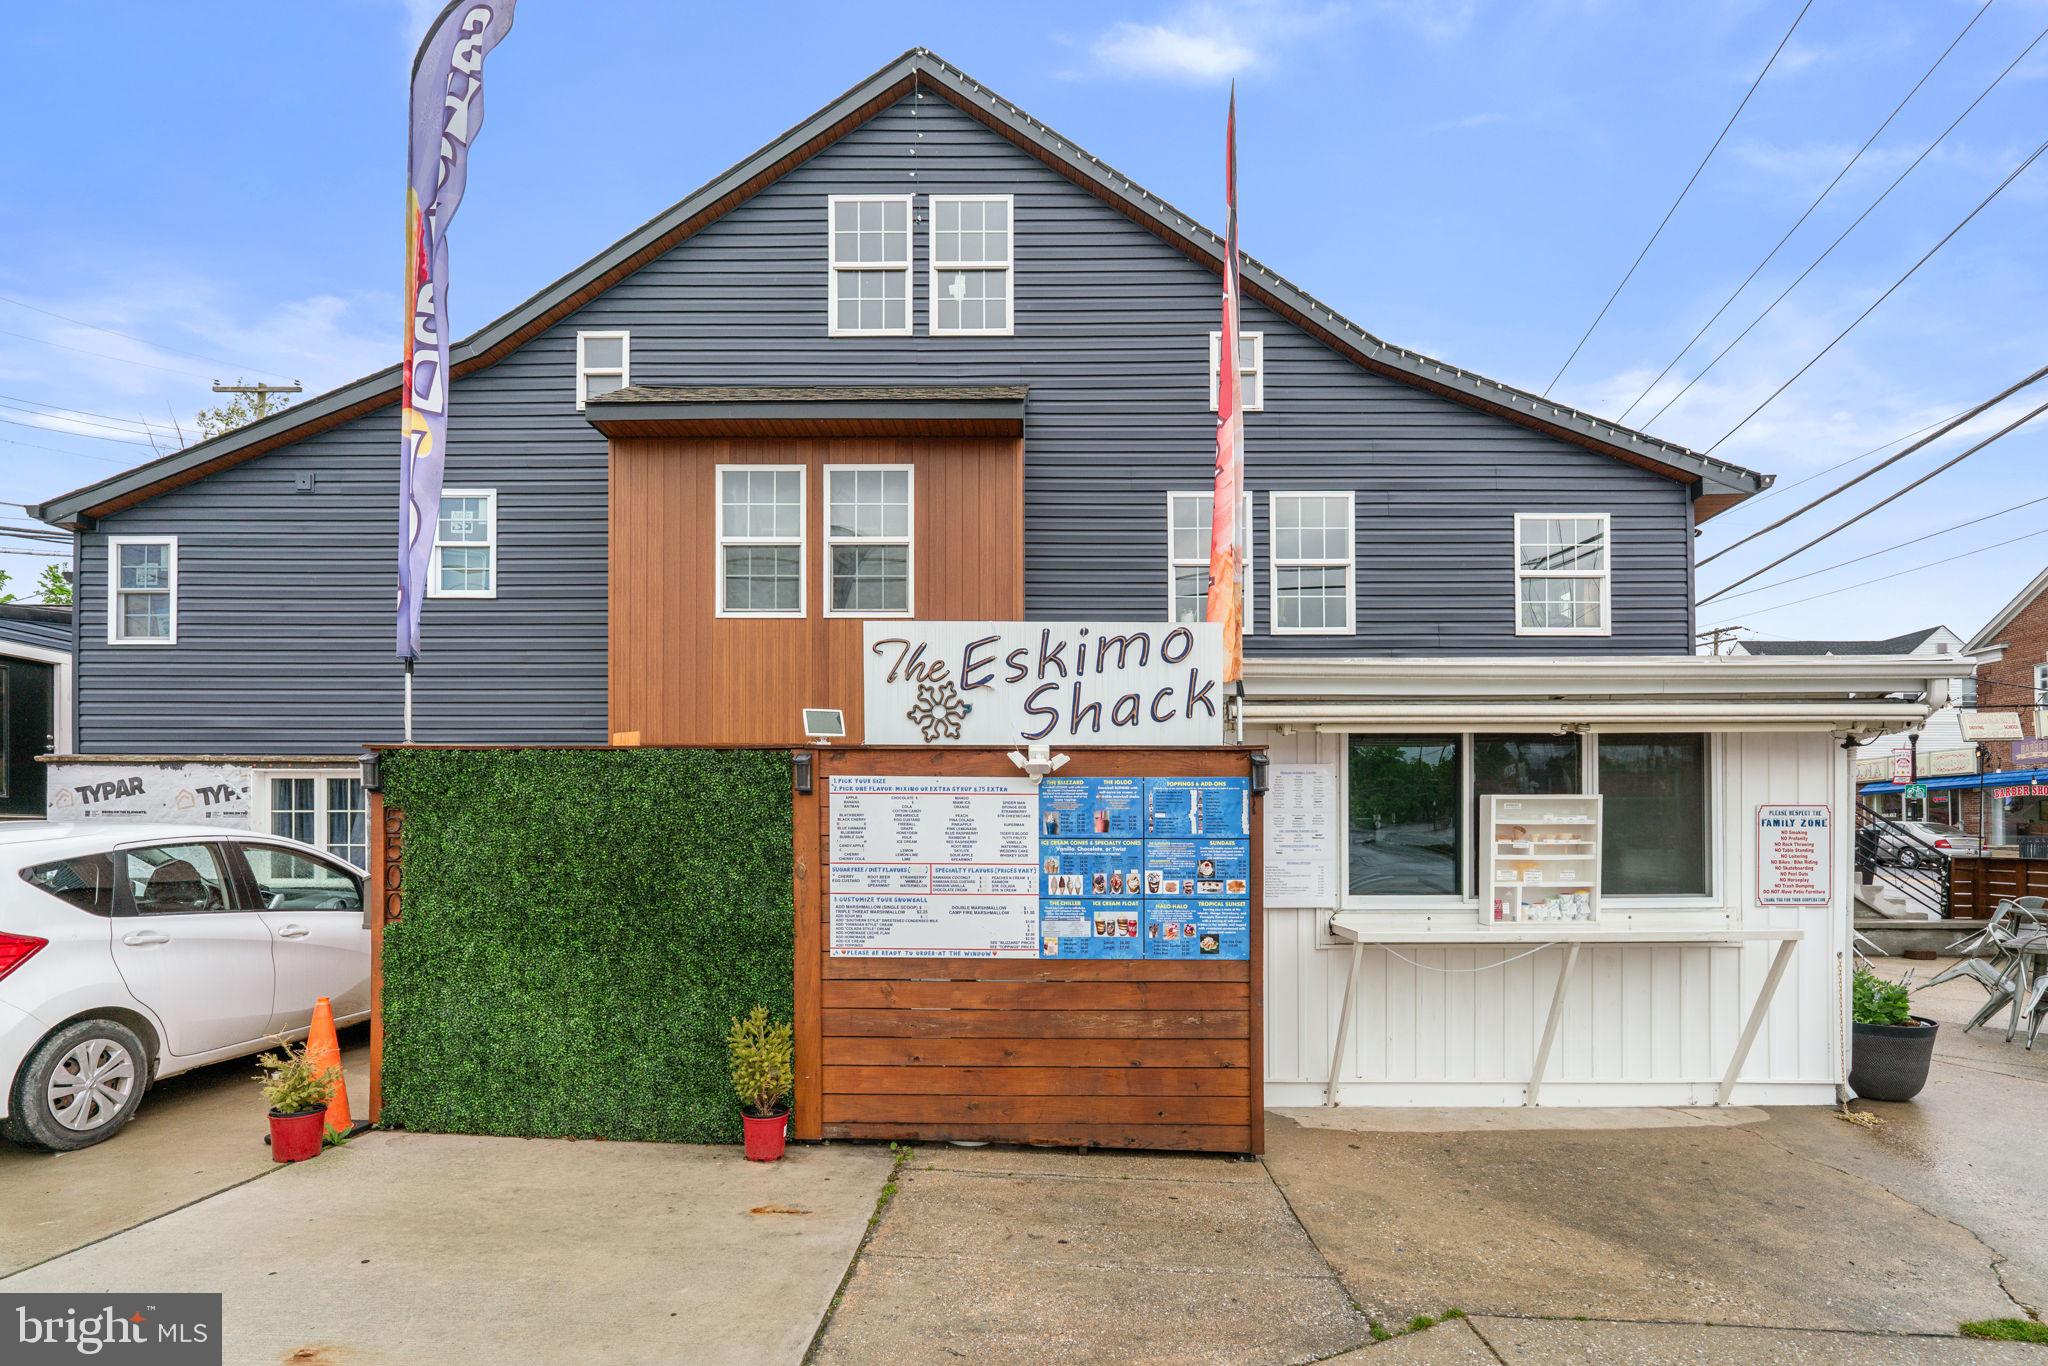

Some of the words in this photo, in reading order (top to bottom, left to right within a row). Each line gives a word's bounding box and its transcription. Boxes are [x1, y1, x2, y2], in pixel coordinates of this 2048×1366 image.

[873, 638, 950, 683] The
[960, 626, 1194, 691] Eskimo
[1020, 667, 1215, 741] Shack
[74, 776, 146, 804] TYPAR
[1994, 786, 2030, 798] BARBER
[1762, 819, 1795, 827] FAMILY
[1800, 819, 1828, 827] ZONE
